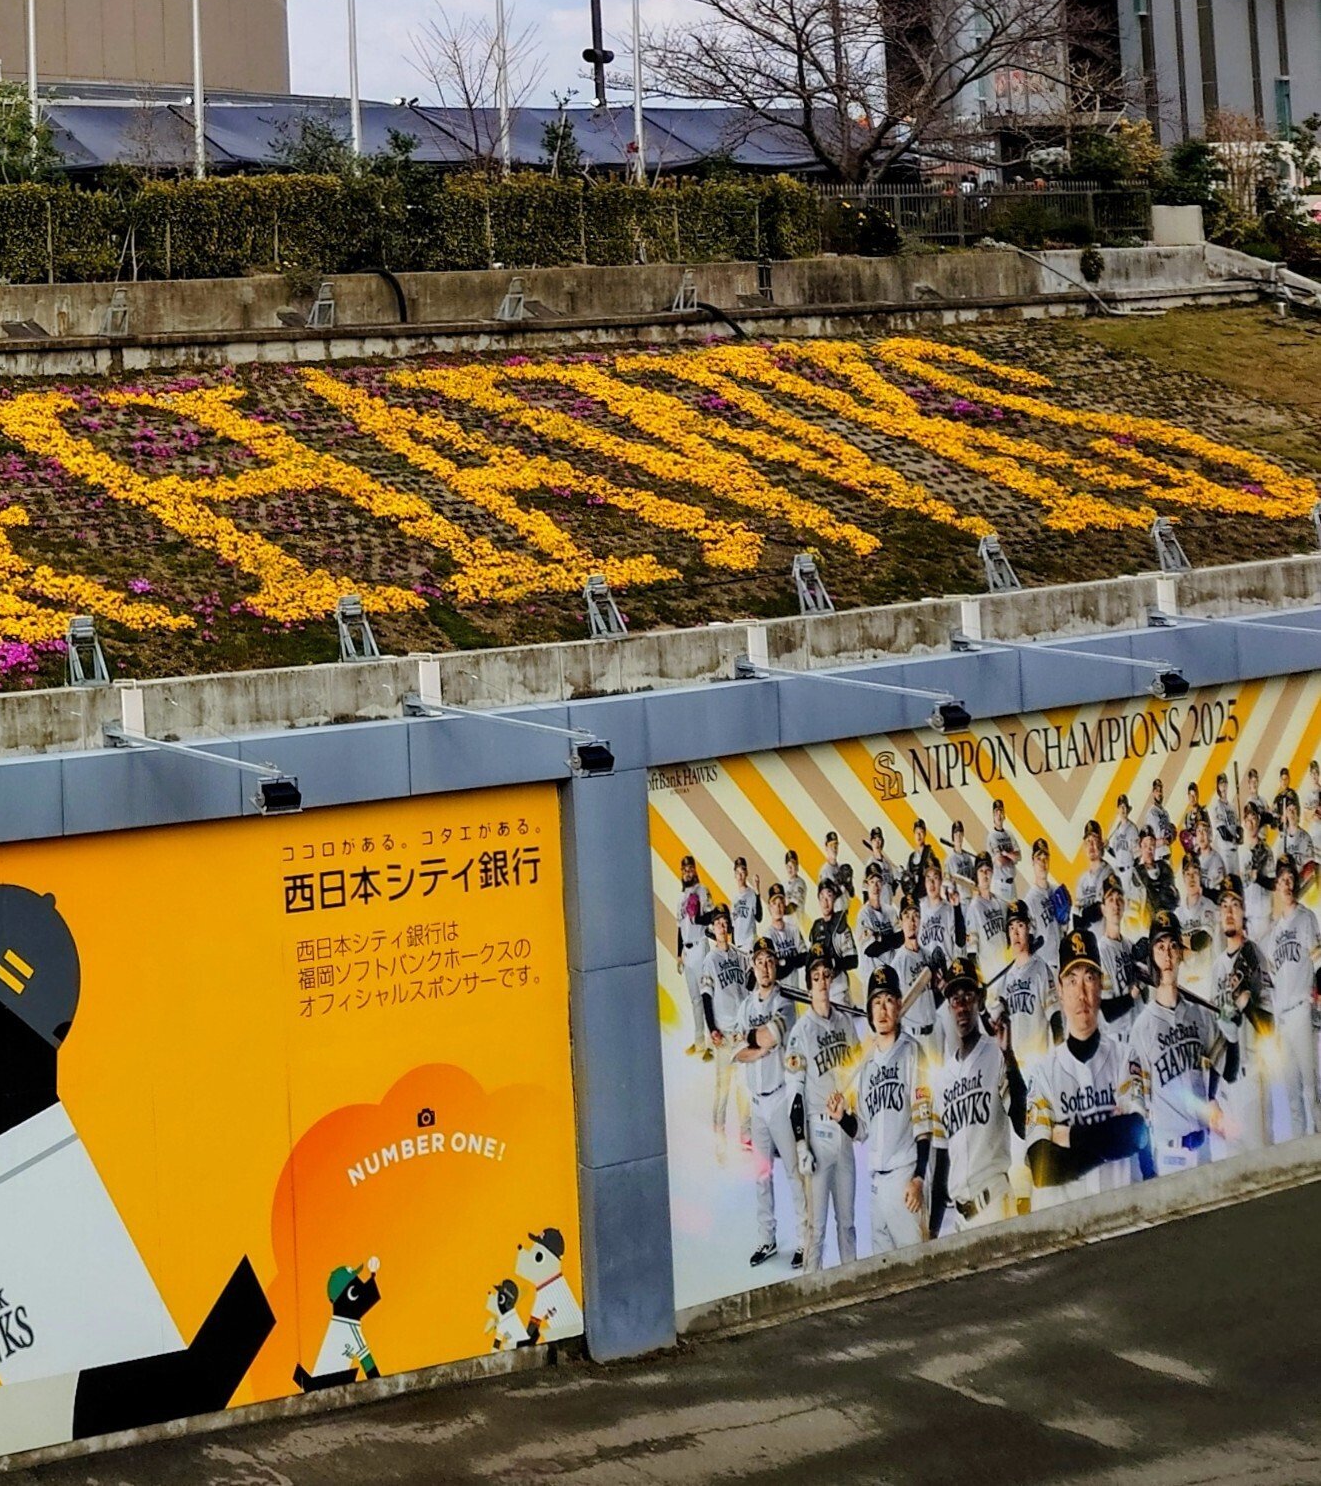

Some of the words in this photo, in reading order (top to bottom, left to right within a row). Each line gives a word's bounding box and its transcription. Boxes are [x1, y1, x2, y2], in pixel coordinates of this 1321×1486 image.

[909, 729, 1022, 796] NIPPON
[1022, 706, 1181, 774] CHAMPIONS
[1189, 699, 1240, 748] 2025
[683, 764, 718, 785] HAWKS
[283, 847, 540, 914] 西日本シティ銀行
[296, 921, 459, 963] 西日本シティ銀行は
[297, 938, 531, 991] 福岡ソフトバンクホークスの
[298, 964, 540, 1018] オフィシャルスポンサーです。
[865, 1081, 905, 1119] HAWKS
[943, 1070, 983, 1104] SoftBank
[1060, 1081, 1117, 1114] SoftBank
[347, 1132, 445, 1187] NUMBER
[450, 1131, 507, 1162] ONE!
